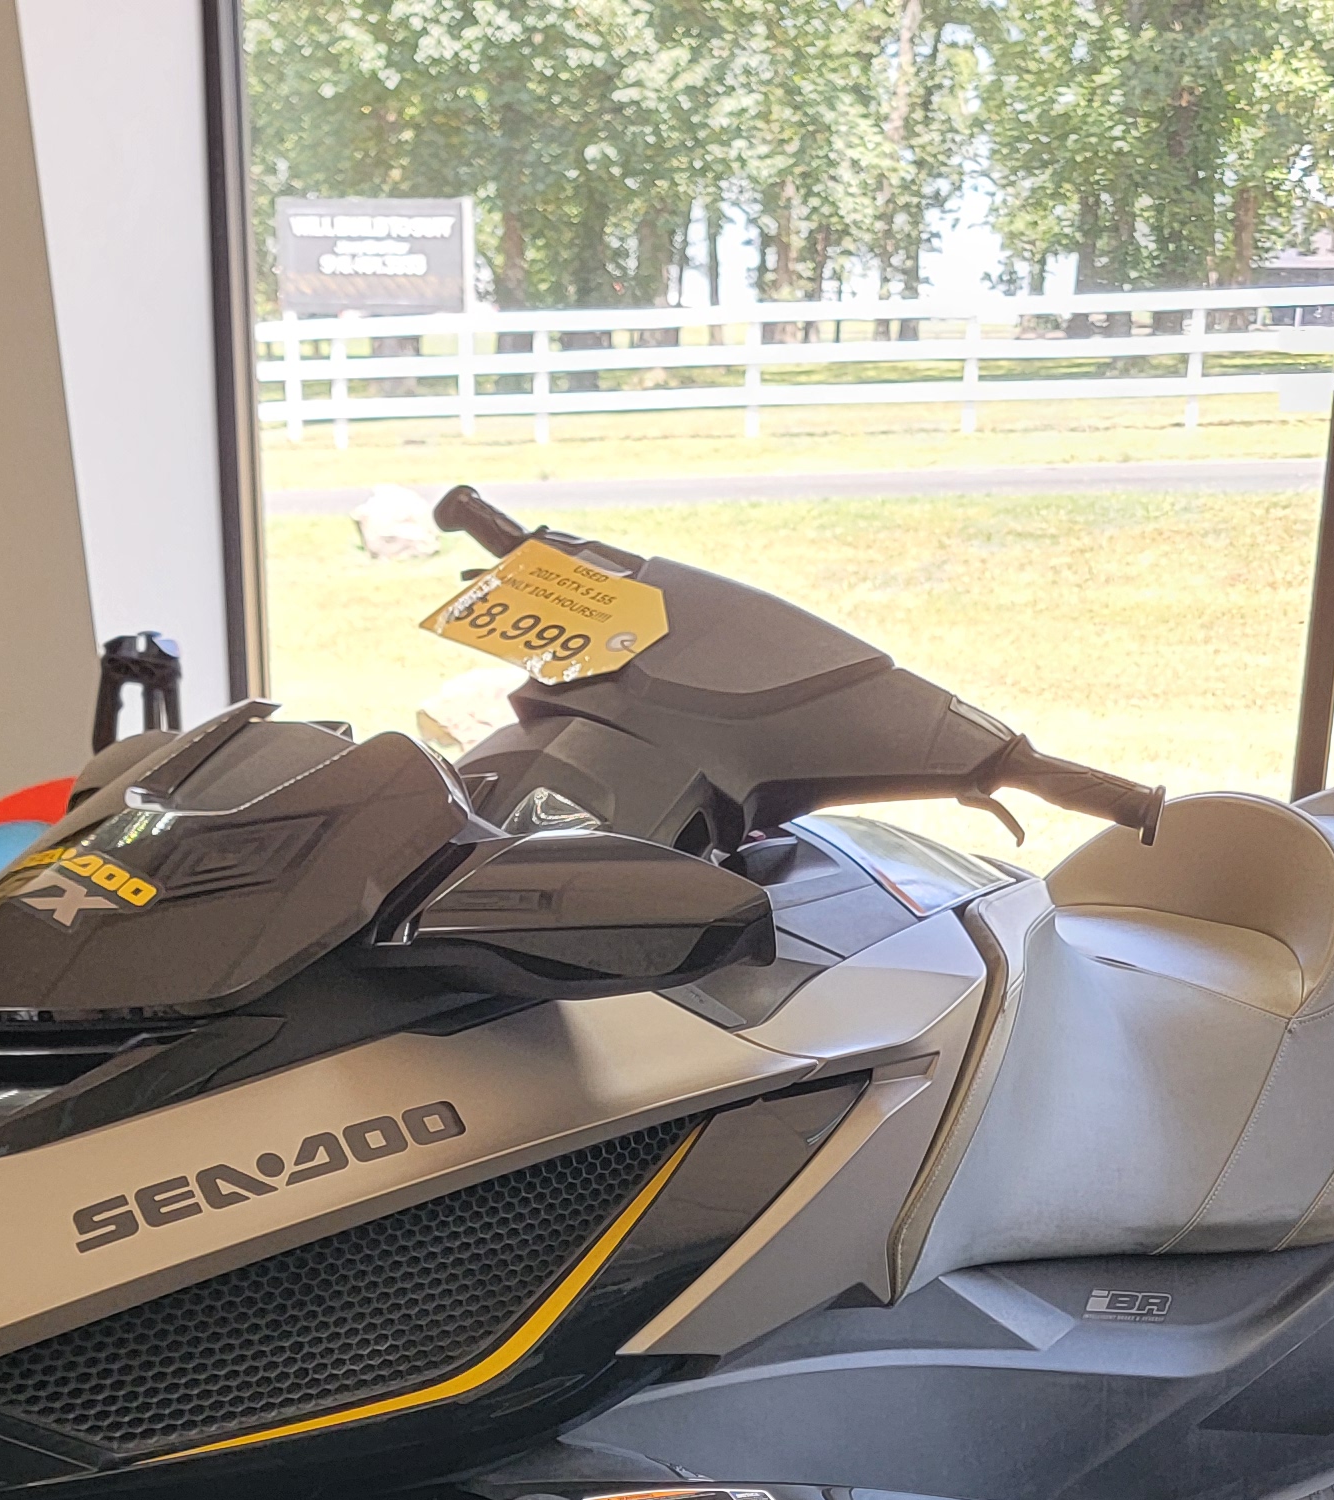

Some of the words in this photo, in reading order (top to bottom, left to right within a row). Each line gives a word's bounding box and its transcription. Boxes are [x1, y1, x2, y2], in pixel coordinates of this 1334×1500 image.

[573, 564, 610, 584] USED
[527, 586, 555, 600] 104
[528, 567, 562, 583] 2017
[556, 578, 585, 594] GTX
[588, 591, 618, 606] 155
